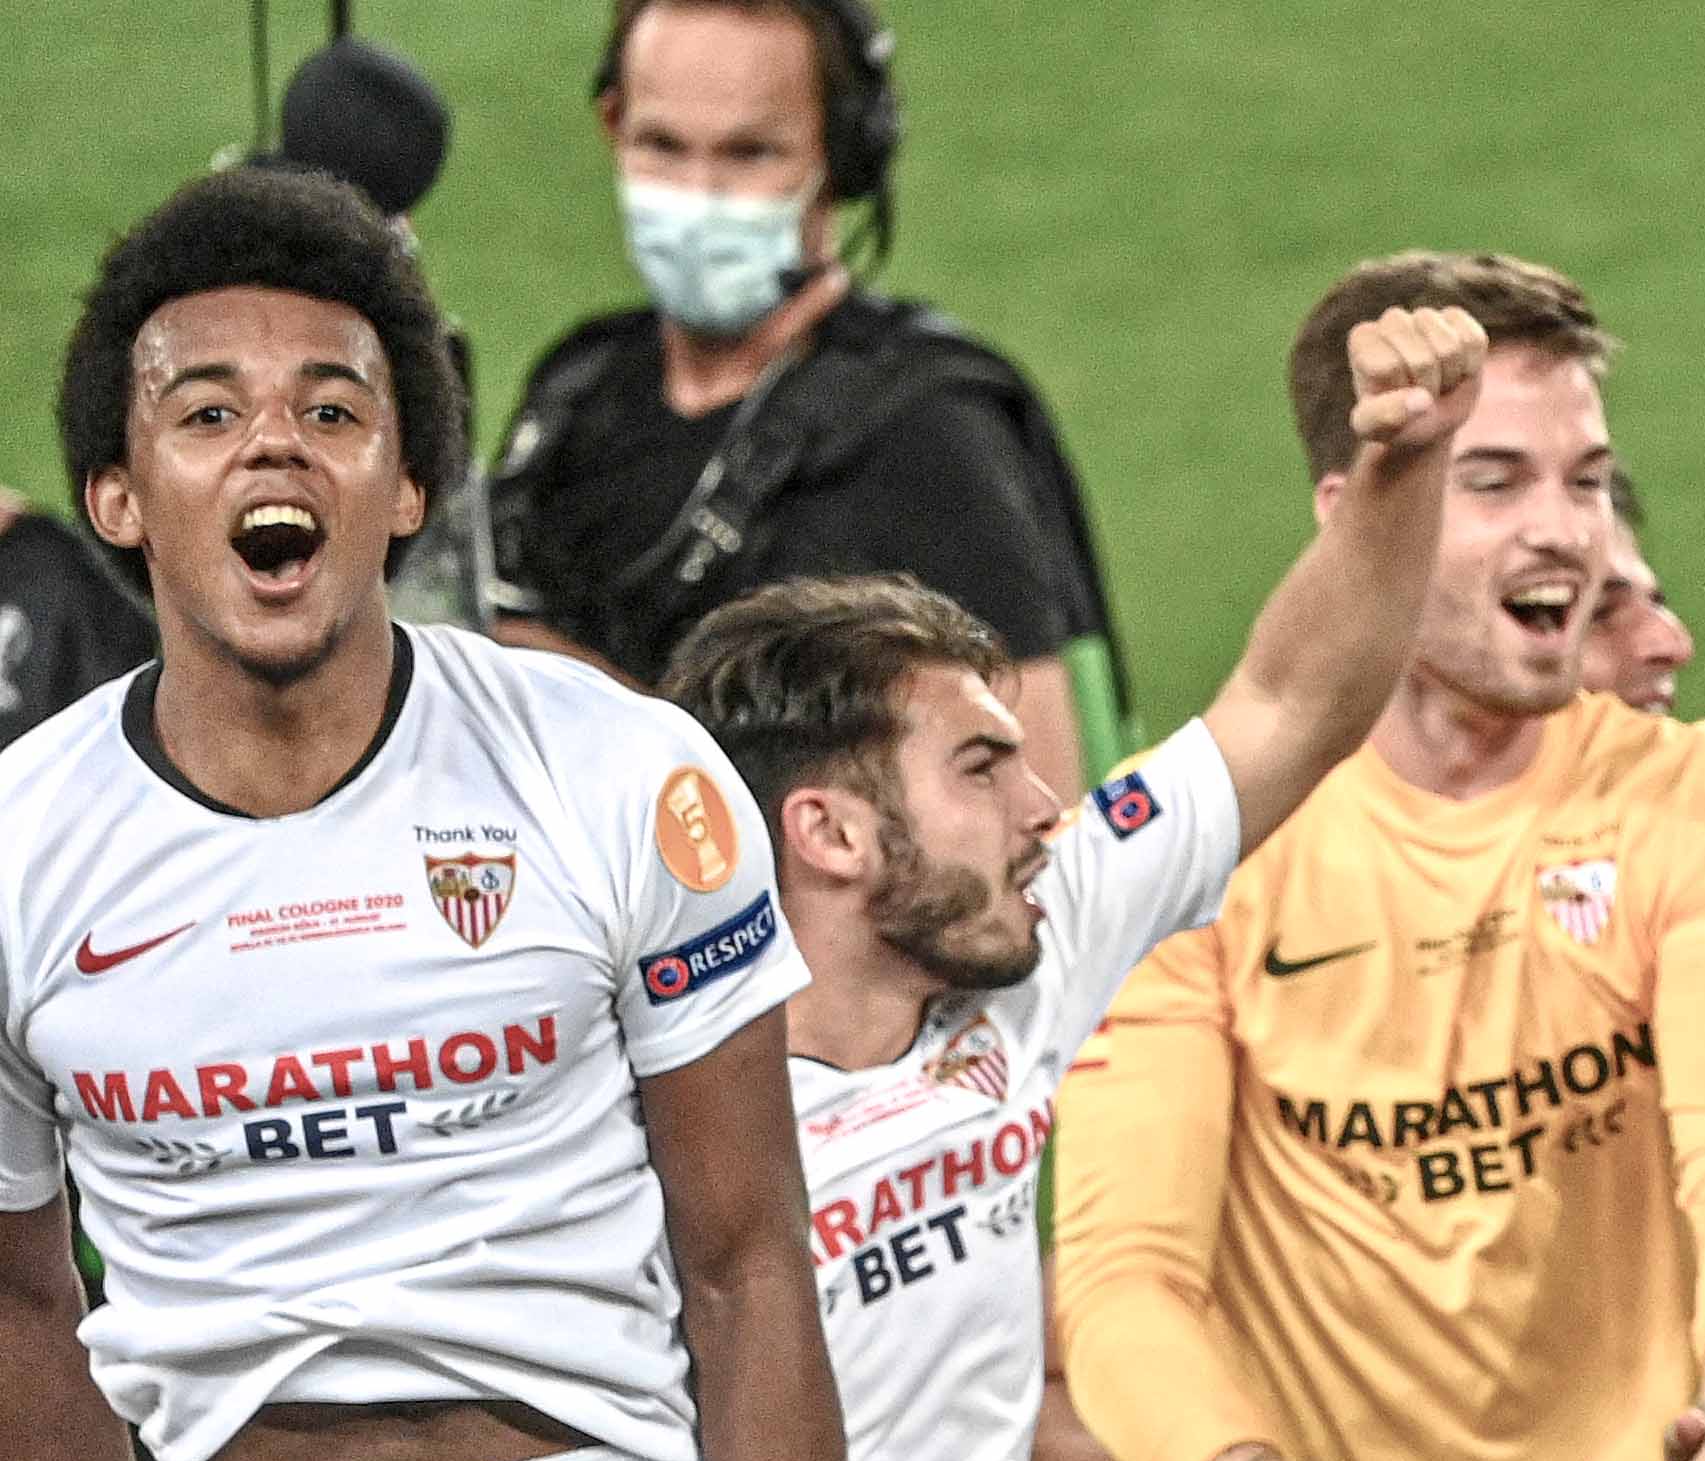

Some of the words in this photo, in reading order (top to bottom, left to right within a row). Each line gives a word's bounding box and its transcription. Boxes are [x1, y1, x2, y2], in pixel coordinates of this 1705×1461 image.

[413, 825, 475, 843] Thank
[482, 825, 518, 842] You
[227, 908, 273, 928] FINAL
[278, 896, 360, 919] COLOGNE
[689, 905, 773, 977] RESPECT
[72, 1016, 558, 1122] MARATHON
[1276, 1021, 1657, 1150] MARATHON
[243, 1101, 407, 1162] BET
[1417, 1126, 1547, 1202] BET
[810, 1097, 1055, 1268] RATHON
[854, 1204, 968, 1306] BET
